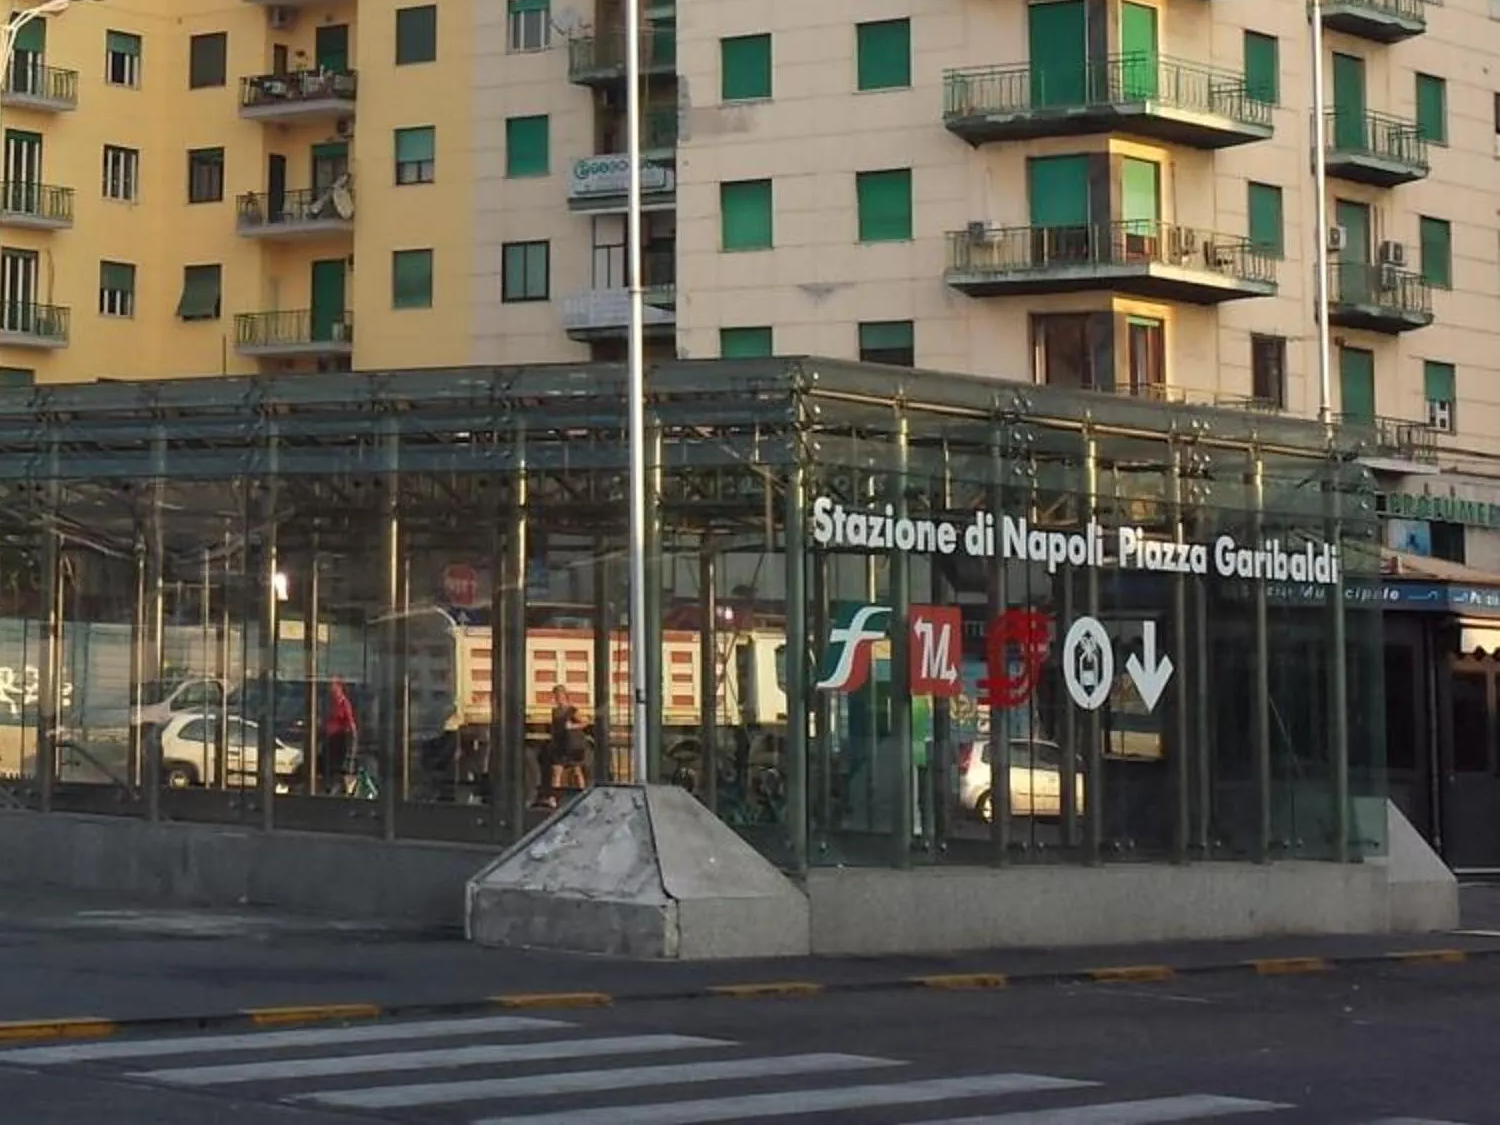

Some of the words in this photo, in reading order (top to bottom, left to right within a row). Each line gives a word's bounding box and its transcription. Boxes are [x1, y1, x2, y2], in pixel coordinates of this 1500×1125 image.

[812, 496, 957, 555] Stazione
[964, 510, 995, 558] di
[1002, 515, 1104, 573] Napoli
[1119, 526, 1208, 575] Piazza
[1215, 535, 1339, 585] Garibaldi
